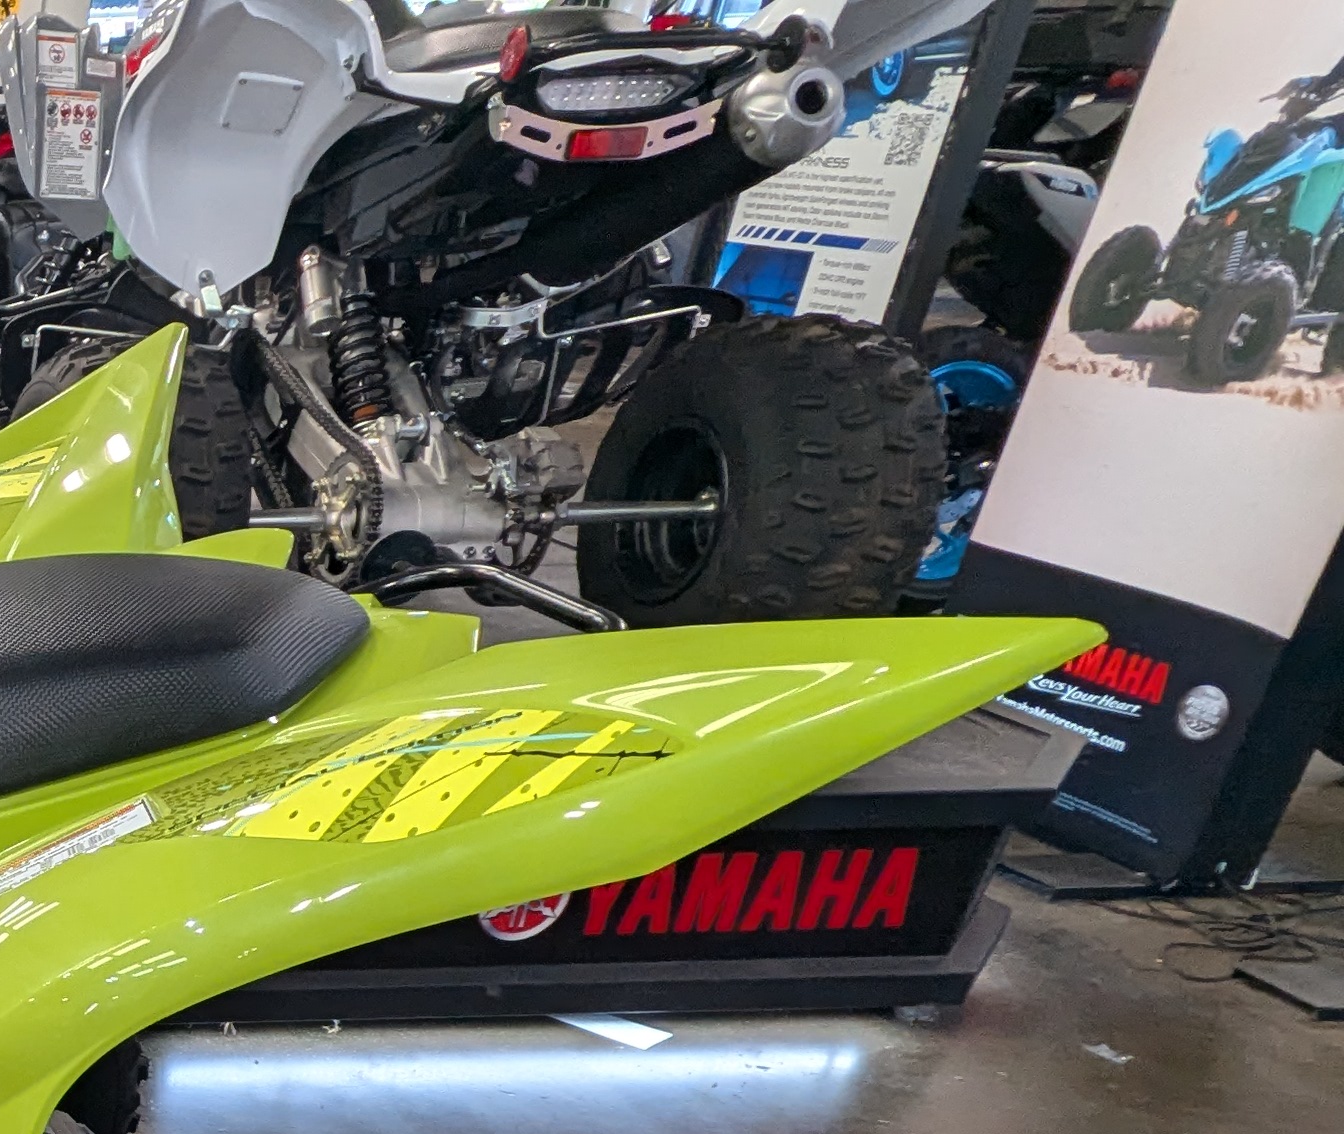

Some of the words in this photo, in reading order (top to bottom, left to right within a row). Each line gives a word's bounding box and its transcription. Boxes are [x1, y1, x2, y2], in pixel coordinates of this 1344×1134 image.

[1063, 643, 1172, 705] MAHA
[1096, 693, 1142, 713] Heart
[583, 847, 920, 936] YAMAHA
